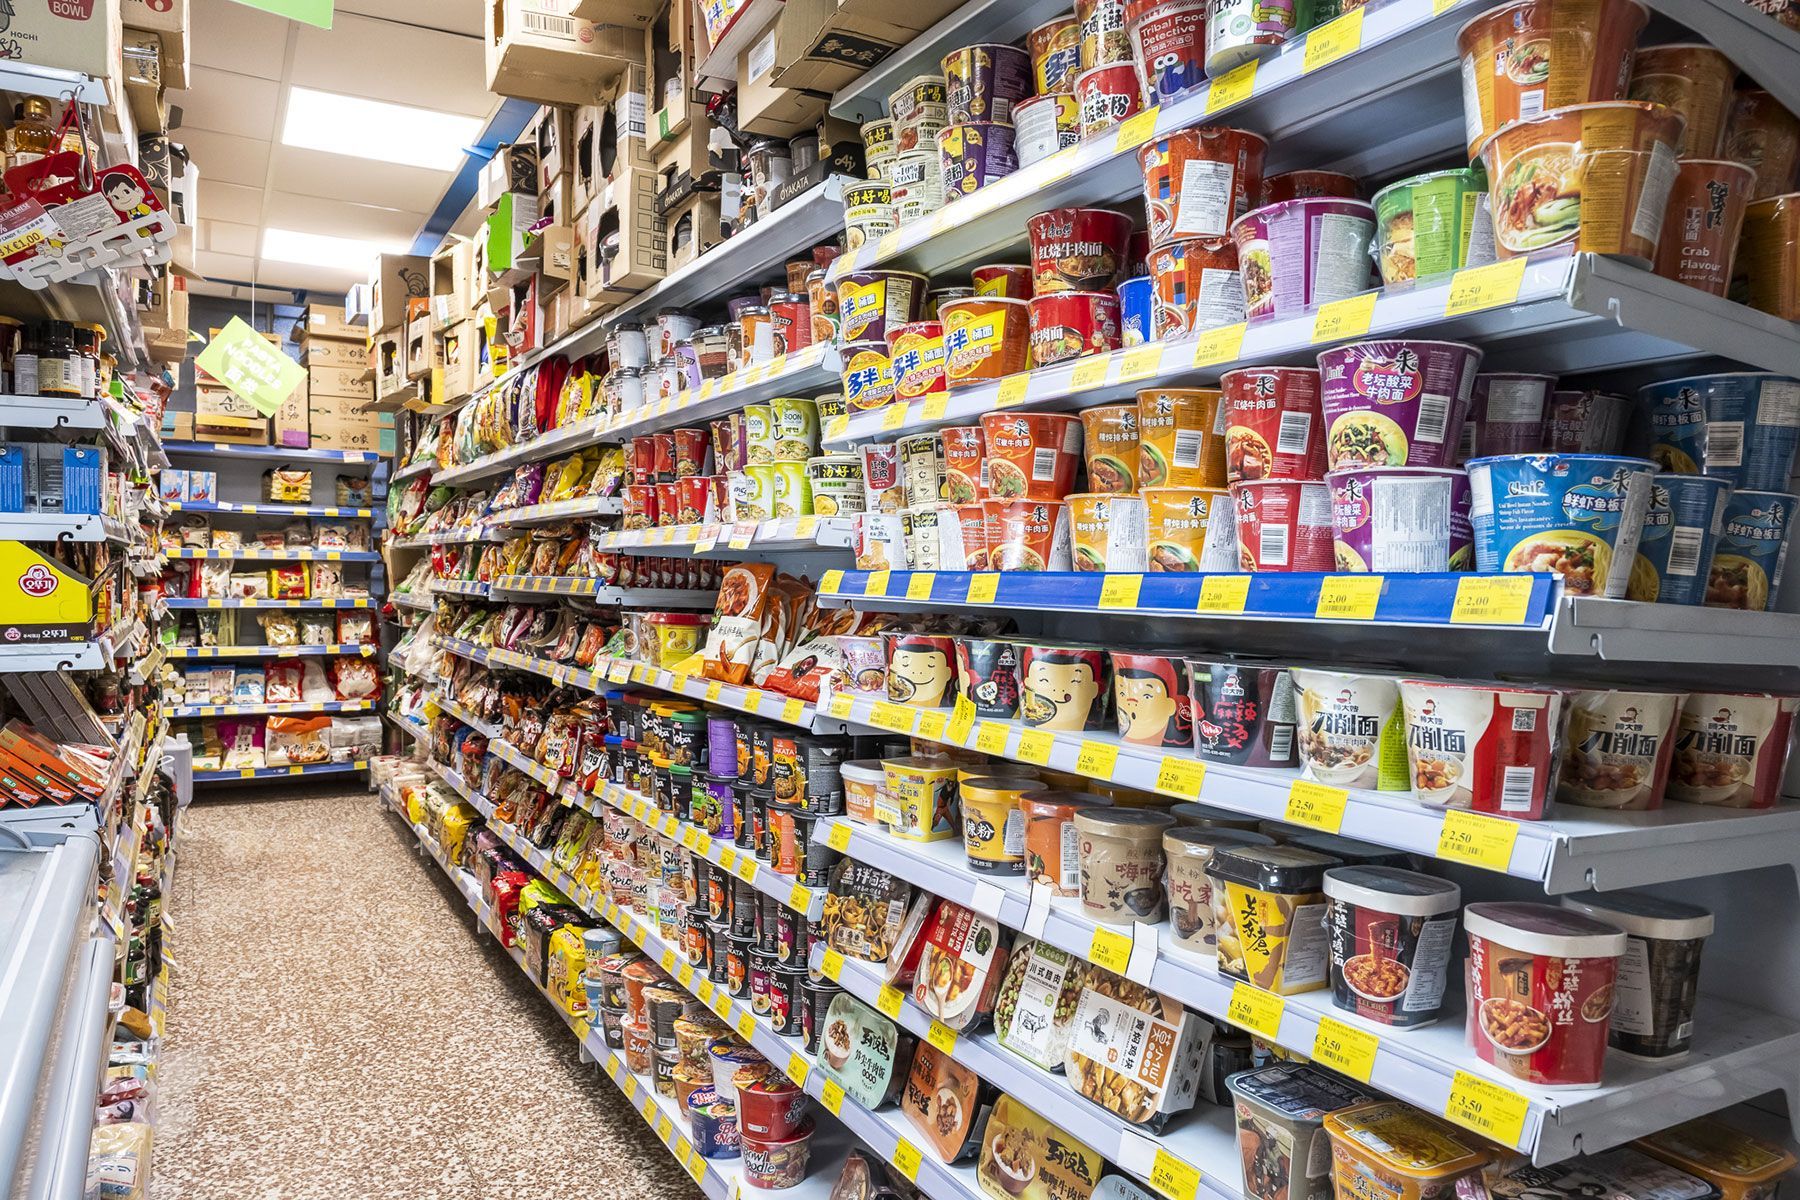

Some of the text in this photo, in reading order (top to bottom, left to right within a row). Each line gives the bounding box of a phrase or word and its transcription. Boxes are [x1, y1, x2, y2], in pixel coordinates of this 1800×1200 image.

[53, 2, 88, 19] BOWL
[1141, 20, 1171, 37] Tribal
[1143, 25, 1195, 47] Detective
[896, 165, 918, 177] -10%
[1039, 241, 1103, 260] 红烧牛肉面
[1682, 247, 1710, 257] Crab
[1680, 260, 1721, 272] Flavour
[1362, 373, 1413, 390] 老坛酸菜
[1367, 387, 1405, 402] 牛肉面
[1233, 399, 1276, 411] 红烧牛肉面
[784, 413, 802, 421] SOON
[1508, 481, 1544, 495] Unif
[1727, 523, 1781, 540] 鲜虾鱼板面
[26, 580, 51, 590] 오뚜기
[1466, 596, 1489, 607] 2,00
[42, 629, 67, 639] 오뚜기
[1312, 710, 1379, 737] 刀削面
[1409, 724, 1466, 755] 刀削面
[1578, 730, 1659, 758] 刀削面
[1675, 730, 1757, 758] 刀削面
[67, 772, 81, 782] MILD
[1296, 800, 1314, 811] 2,50
[1449, 831, 1472, 844] 2,50
[610, 870, 631, 887] Spic
[1235, 1001, 1252, 1014] 3,50
[1321, 1036, 1341, 1051] 3,50
[1459, 1095, 1482, 1113] 3,50
[718, 1122, 738, 1135] Bo
